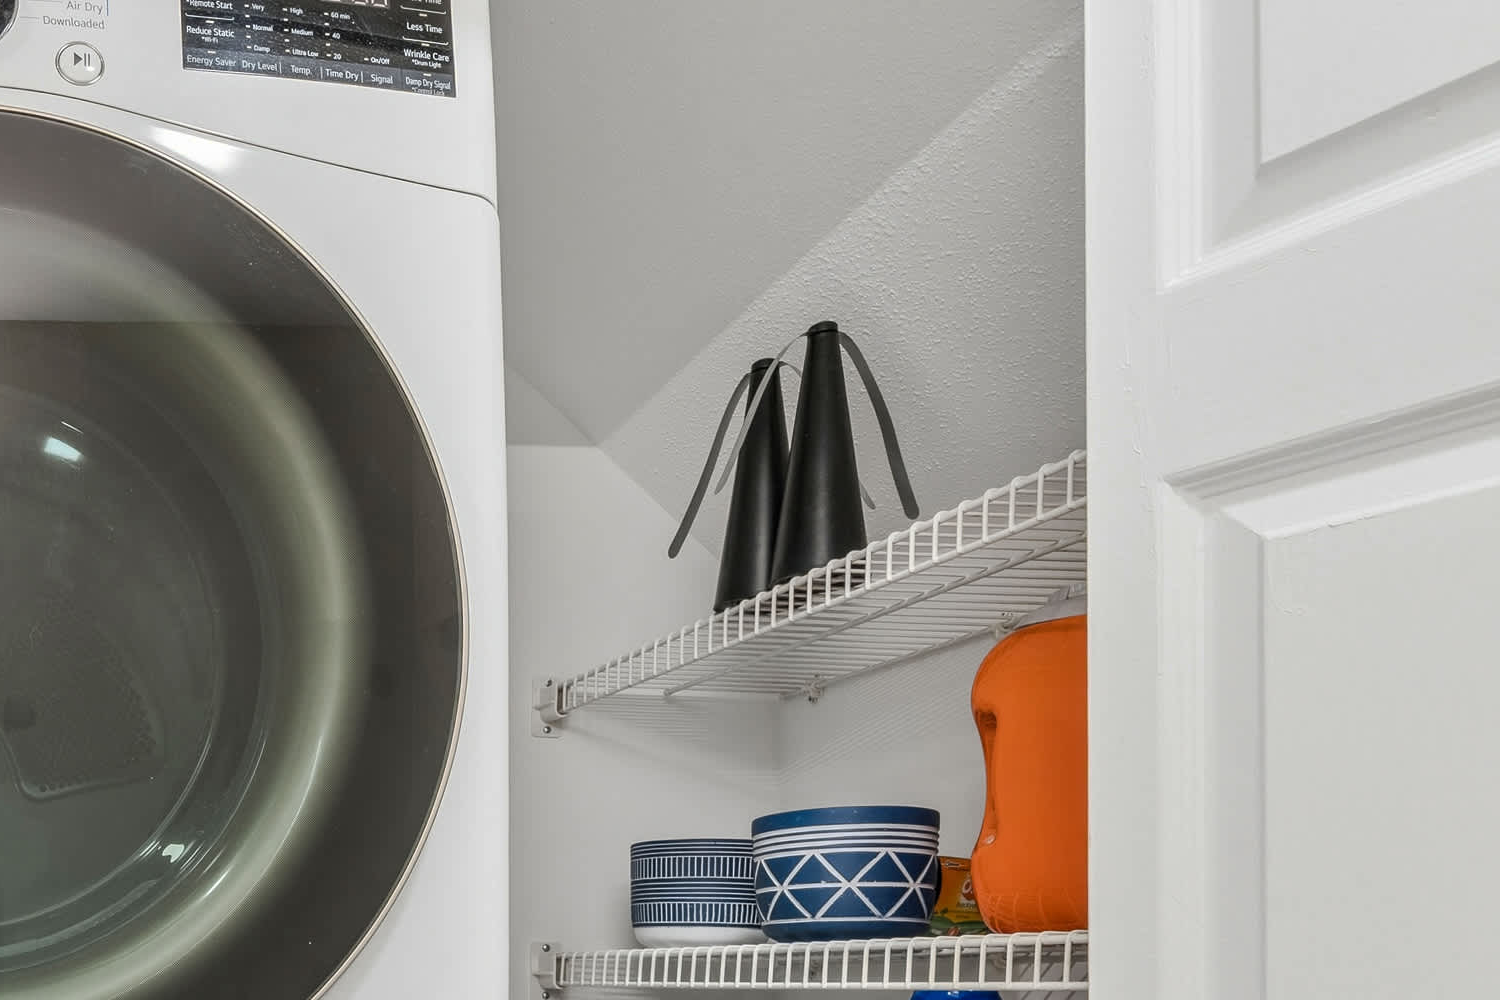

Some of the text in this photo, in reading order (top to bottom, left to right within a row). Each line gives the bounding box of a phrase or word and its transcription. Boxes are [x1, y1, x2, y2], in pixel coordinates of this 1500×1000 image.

[67, 0, 103, 15] Air Dry
[215, 0, 233, 10] Start
[251, 3, 265, 11] Very
[43, 15, 104, 29] Downloaded
[252, 24, 274, 32] Normal
[406, 21, 443, 34] Less Time
[186, 25, 235, 38] Reduce Static
[332, 32, 341, 40] 40
[187, 55, 237, 67] Energy Saver
[403, 48, 450, 62] Wrinkle Care
[242, 60, 278, 71] Dry Level
[326, 68, 359, 81] Time Dry
[370, 73, 394, 85] Signal
[405, 77, 451, 91] Damp Dry Signal
